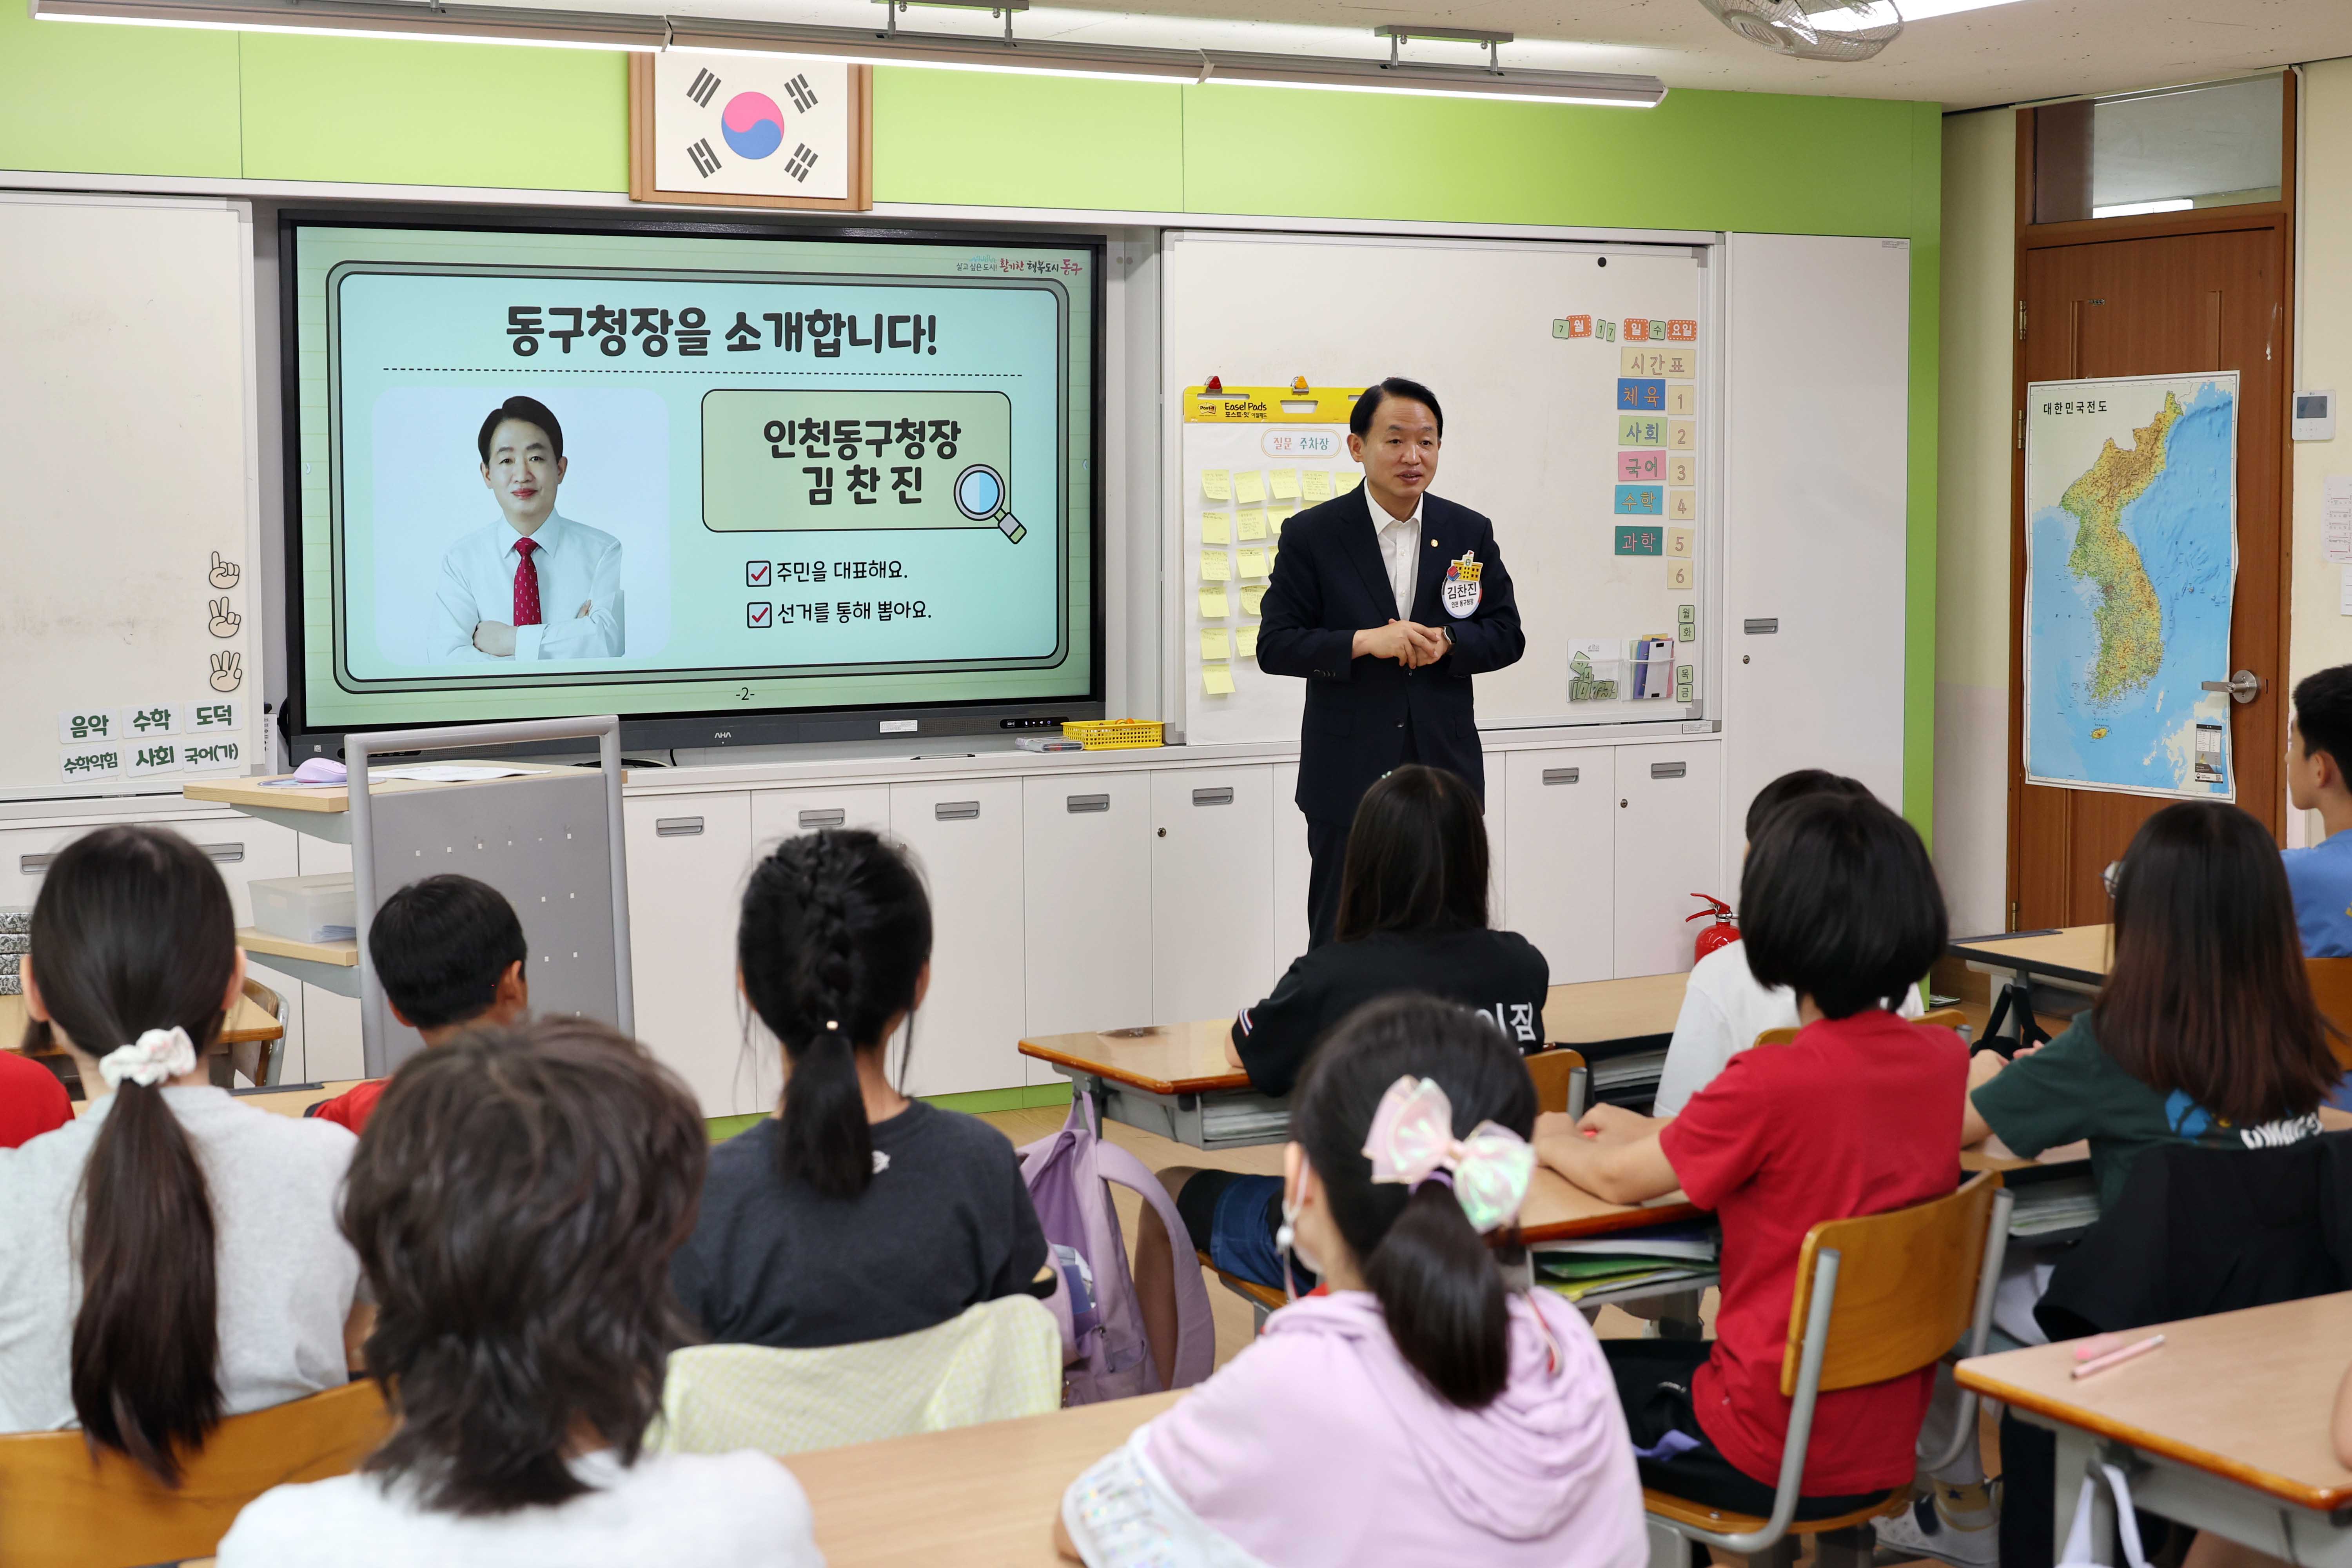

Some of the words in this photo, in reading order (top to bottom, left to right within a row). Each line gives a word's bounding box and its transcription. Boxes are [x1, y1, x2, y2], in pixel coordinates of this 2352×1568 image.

[1000, 258, 1024, 272] 활기찬
[1027, 260, 1059, 274] 행복도시
[1060, 259, 1083, 276] 동구
[507, 305, 711, 357] 동구청장을
[725, 309, 936, 358] 소개합니다!
[1632, 354, 1685, 375] 시간표
[1225, 402, 1246, 411] Easel
[1248, 402, 1267, 411] Pads
[1623, 385, 1661, 407] 체육
[1678, 394, 1682, 409] 1
[2043, 401, 2107, 415] 대한민국전도
[764, 418, 961, 460] 인천동구청장
[1274, 437, 1292, 450] 질문
[1299, 437, 1329, 450] 주차장
[1626, 422, 1659, 443] 사회
[1678, 429, 1686, 444] 2
[1626, 456, 1657, 478] 국어
[1677, 465, 1686, 480] 3
[1622, 492, 1656, 512] 수학
[1678, 499, 1686, 514] 4
[1622, 533, 1656, 552] 과학
[1675, 537, 1684, 552] 5
[777, 561, 827, 582] 주민을
[834, 560, 908, 580] 대표해요.
[1676, 568, 1684, 584] 6
[1447, 582, 1477, 599] 김찬진
[777, 603, 829, 623] 선거를
[837, 601, 870, 623] 통해
[878, 601, 932, 622] 뽑아요.
[1460, 599, 1474, 607] 동구청장
[70, 715, 109, 738] 음악
[133, 708, 171, 732] 수학
[196, 705, 232, 726] 도덕
[64, 752, 118, 774] 수학익힘
[136, 746, 174, 767] 사회
[185, 743, 238, 764] 국어(가)
